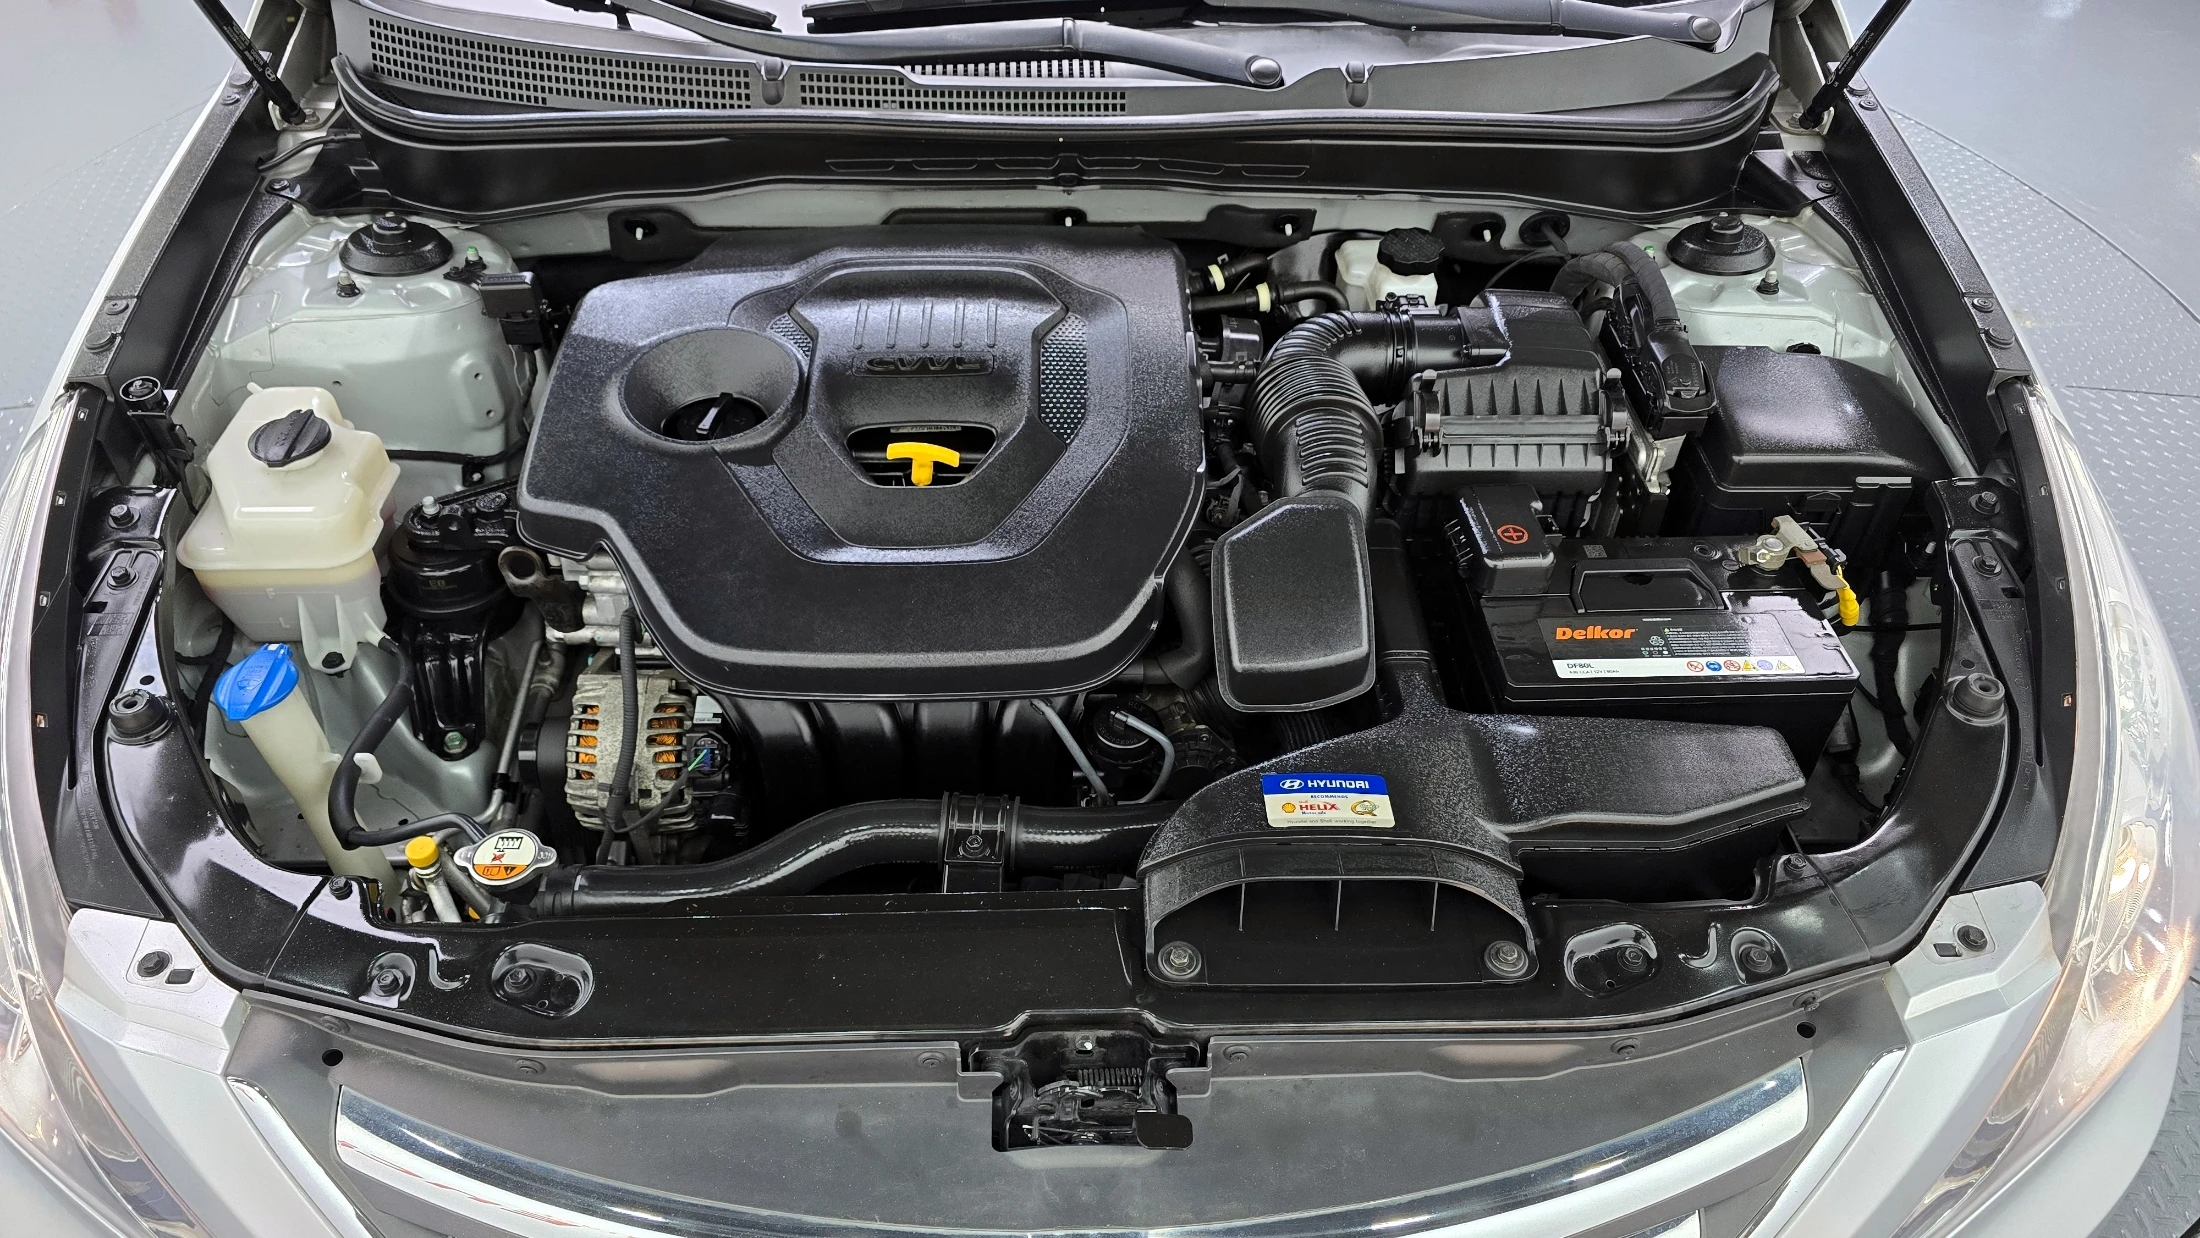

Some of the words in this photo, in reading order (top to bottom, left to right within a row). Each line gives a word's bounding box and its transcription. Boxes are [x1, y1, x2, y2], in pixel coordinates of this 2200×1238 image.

[1555, 625, 1636, 640] Delkor
[1307, 779, 1370, 789] HYUNDAI
[1299, 803, 1339, 811] HELIX
